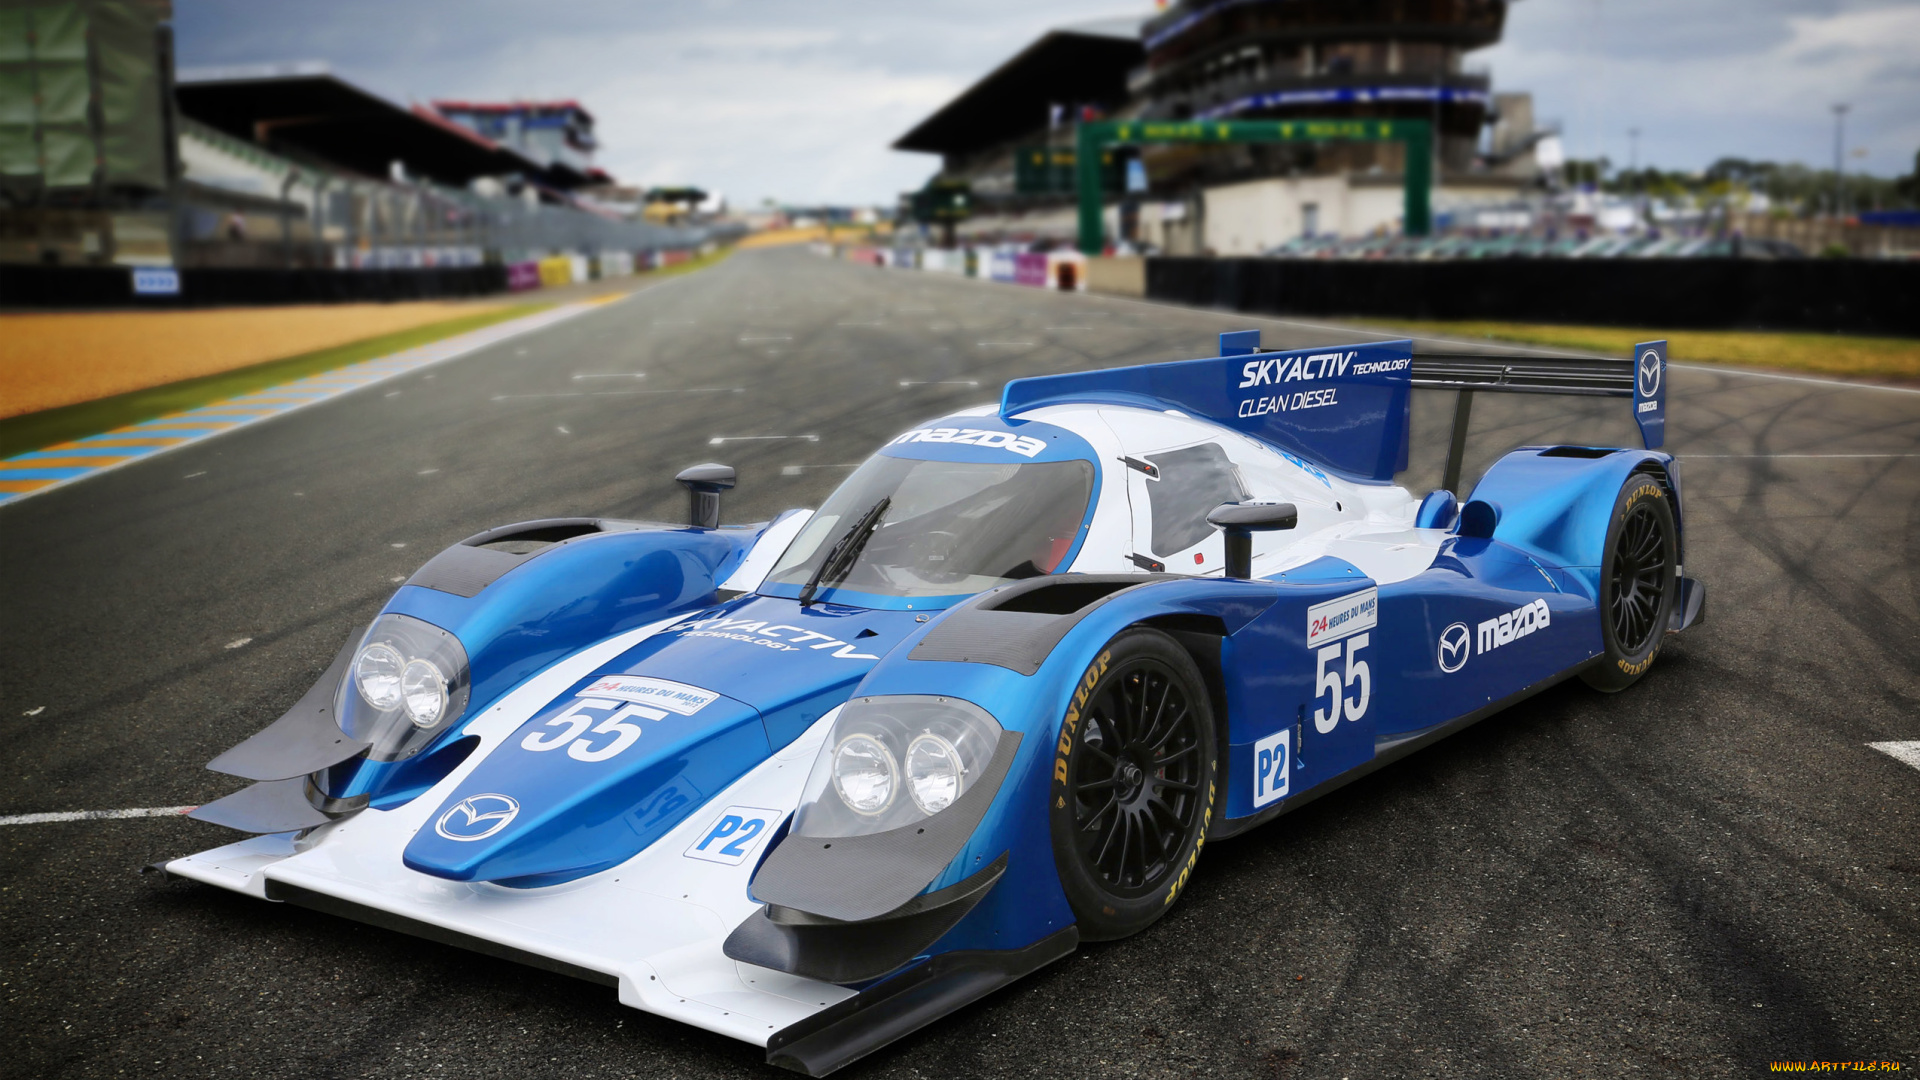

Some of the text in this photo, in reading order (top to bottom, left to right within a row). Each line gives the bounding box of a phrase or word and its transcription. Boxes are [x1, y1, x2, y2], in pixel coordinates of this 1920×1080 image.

[1238, 352, 1411, 389] SKYACTIV TECHNOLOGY
[1238, 388, 1338, 418] CLEAN DIESEL
[1625, 484, 1663, 513] DUNLOP
[1310, 597, 1376, 638] 24 HEURES DU MANS
[1314, 632, 1371, 734] 55
[1617, 650, 1654, 675] DUNLOP
[587, 682, 708, 704] 24 HEURES DU MANS
[520, 698, 670, 762] 55
[1054, 649, 1111, 786] DUNLOP
[1258, 743, 1286, 798] P2
[696, 815, 766, 857] P2
[1164, 779, 1216, 905] DUNLOP
